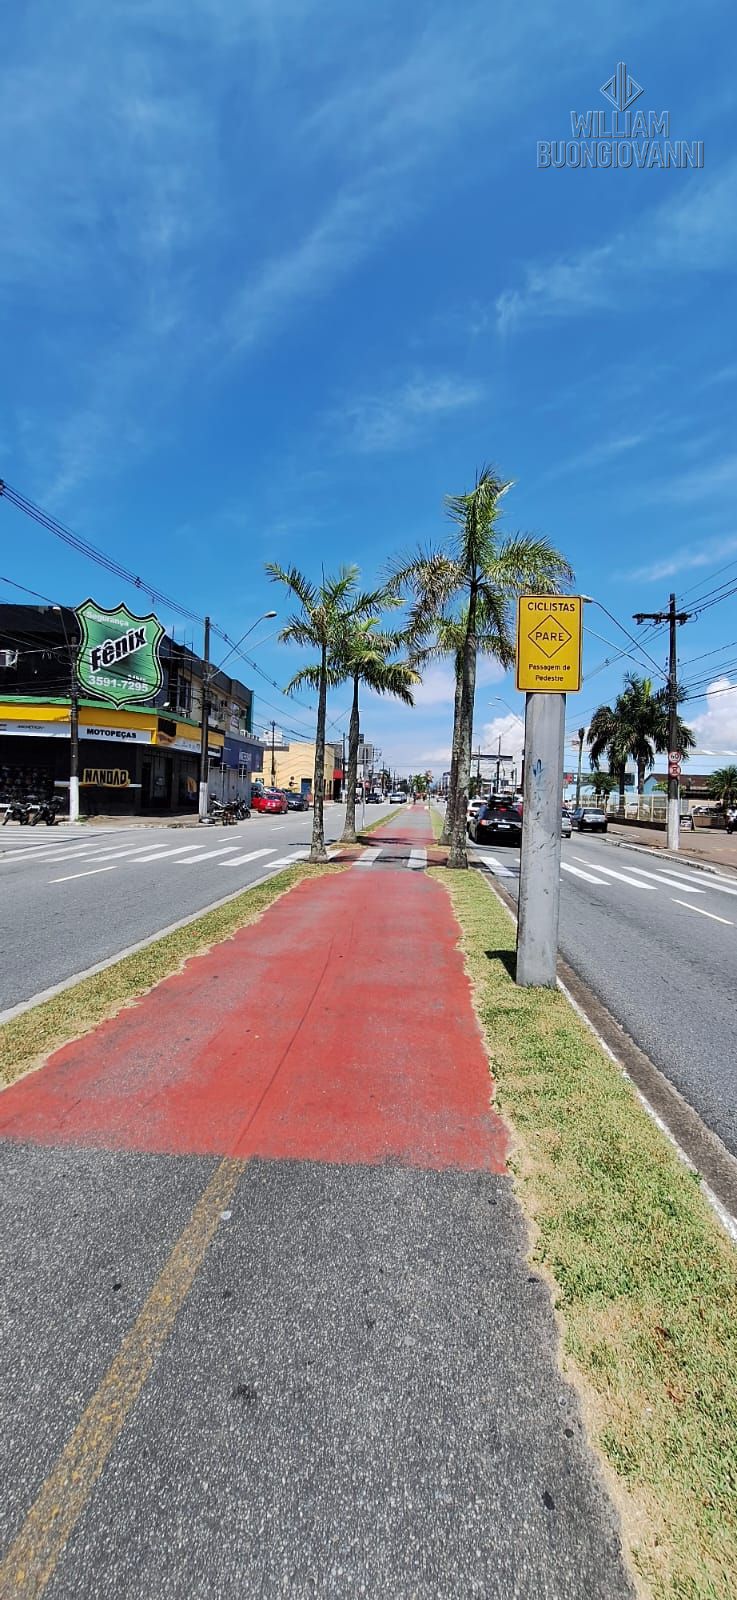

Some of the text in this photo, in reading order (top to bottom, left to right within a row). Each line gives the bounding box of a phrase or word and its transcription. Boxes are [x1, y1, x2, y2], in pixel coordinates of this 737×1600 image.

[527, 601, 575, 612] CICLISTAS
[535, 632, 564, 641] PARE
[90, 626, 148, 673] Fênix
[528, 663, 560, 671] Passagem
[88, 675, 149, 692] 3591-7295
[86, 728, 137, 739] MOTOPEÇAS
